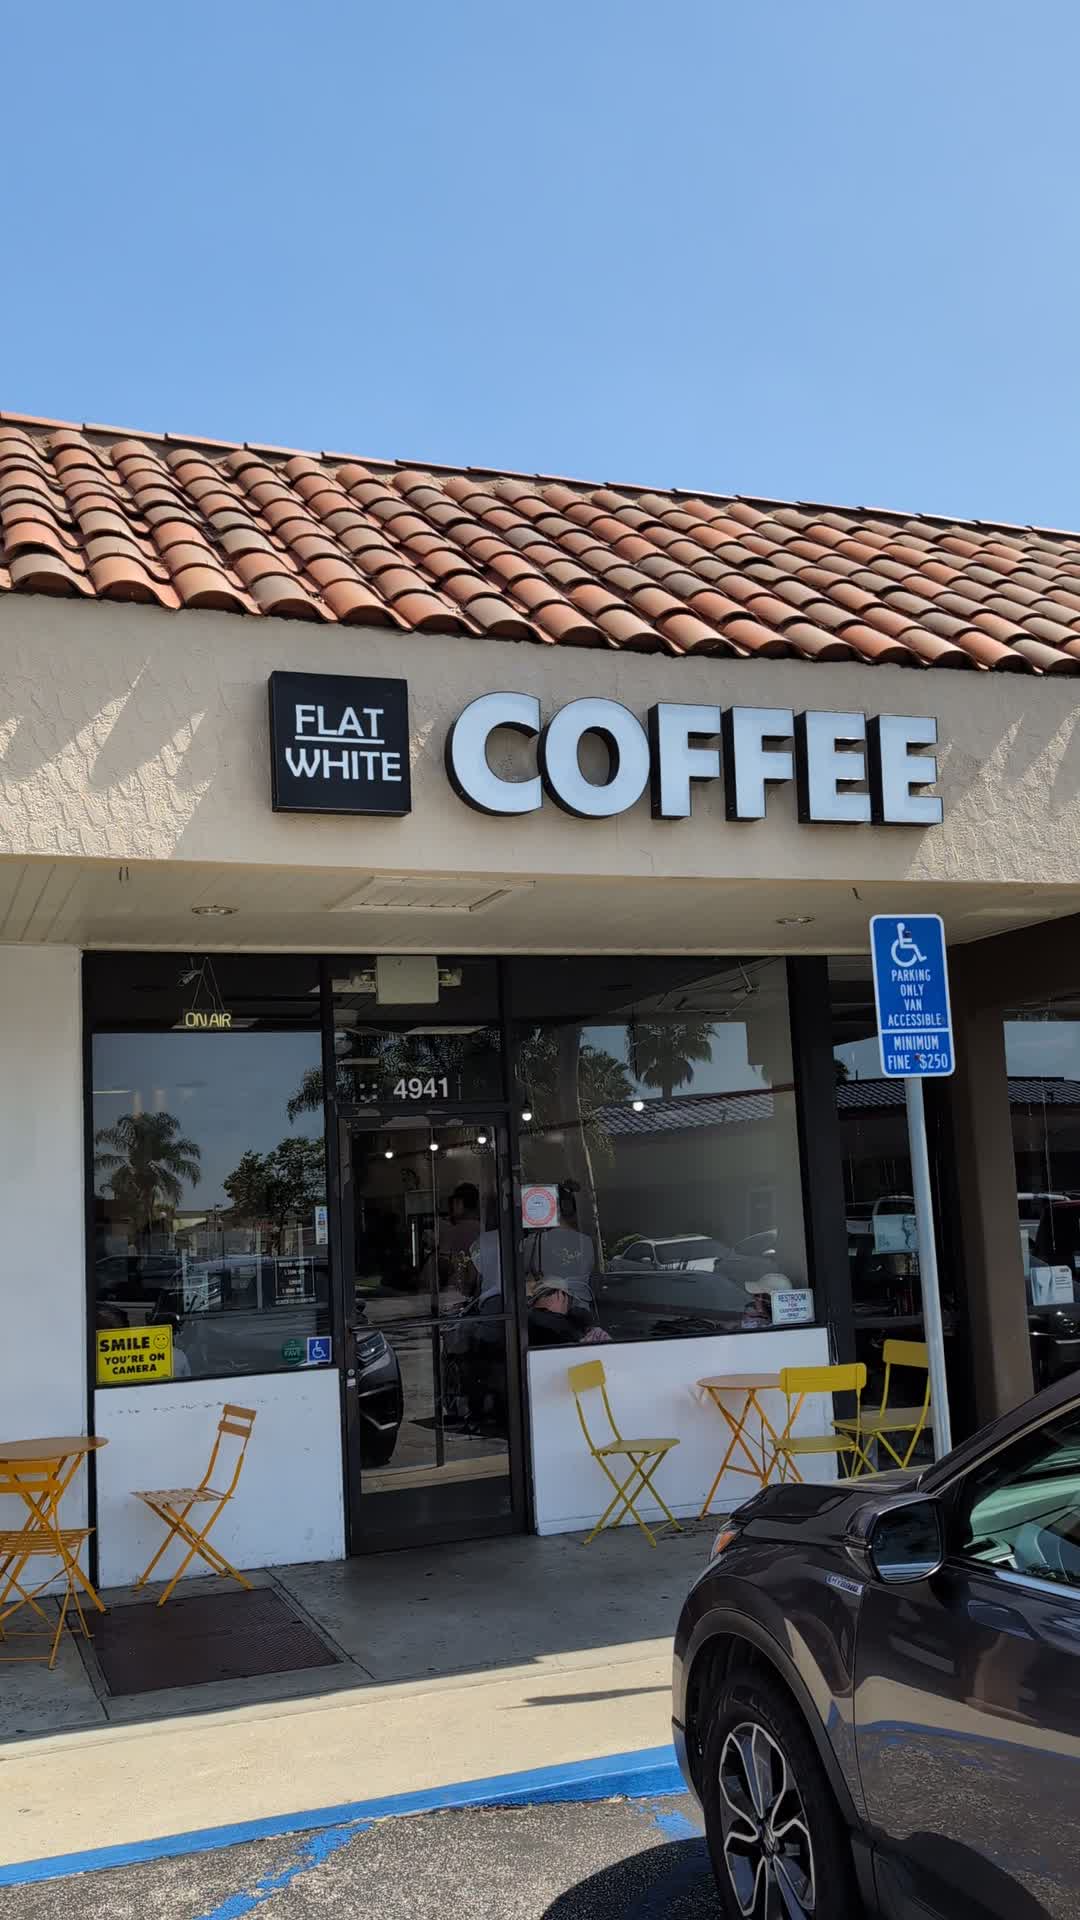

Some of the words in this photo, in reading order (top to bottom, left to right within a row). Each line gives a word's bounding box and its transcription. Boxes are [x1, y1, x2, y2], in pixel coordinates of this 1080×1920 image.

[295, 704, 384, 737] FLAT
[285, 747, 402, 782] WHITE
[444, 691, 944, 826] COFFEE
[891, 969, 931, 982] PARKING
[900, 983, 924, 997] ONLY
[904, 998, 922, 1011] VAN
[185, 1012, 208, 1027] ON
[209, 1013, 231, 1028] AIR
[888, 1013, 942, 1027] ACCESSIBLE
[893, 1035, 939, 1051] MINIMUM
[887, 1054, 911, 1070] FINE
[919, 1053, 948, 1070] $250
[393, 1077, 448, 1099] 4941
[99, 1336, 150, 1353] SMILE
[104, 1354, 145, 1366] YOU'RE
[149, 1353, 165, 1362] ON
[112, 1363, 157, 1375] CAMERA
